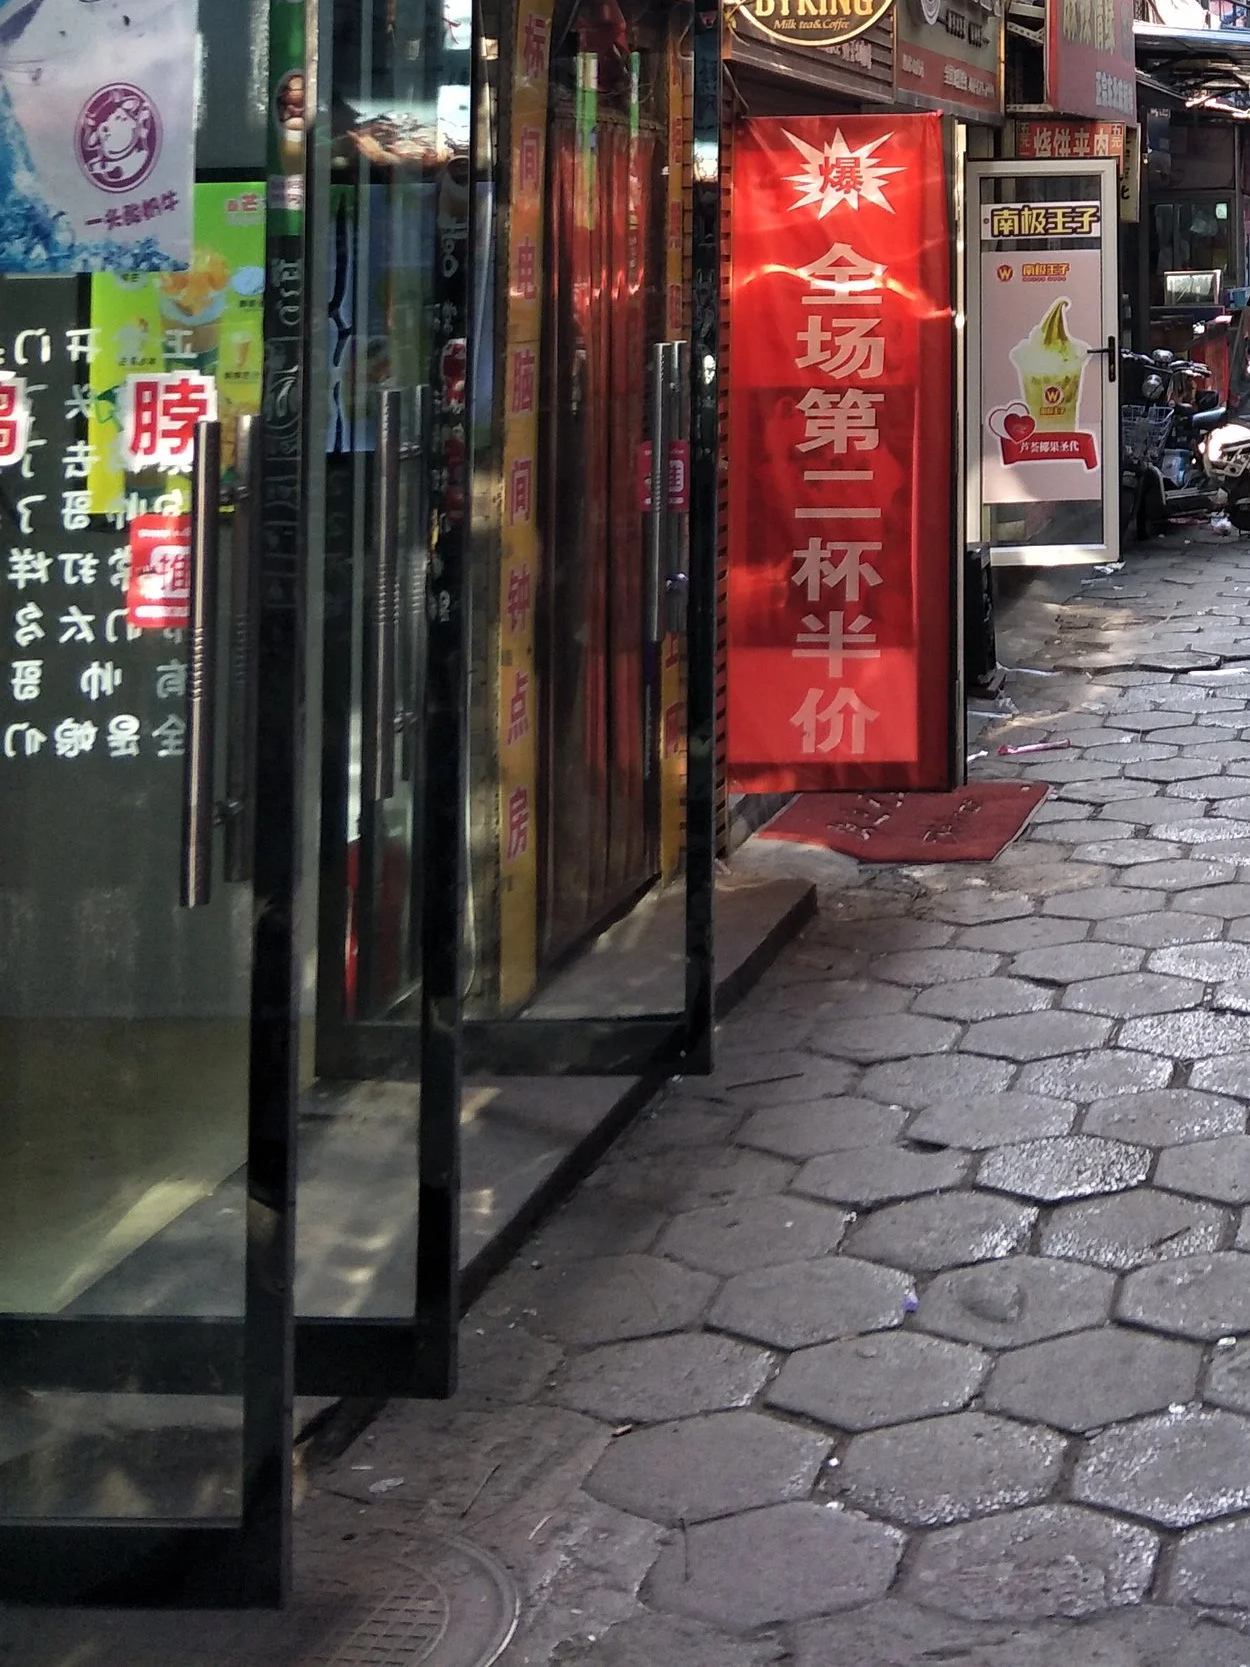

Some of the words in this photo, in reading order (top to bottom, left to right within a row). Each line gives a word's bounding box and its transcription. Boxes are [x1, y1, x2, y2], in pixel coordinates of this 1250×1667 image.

[818, 155, 865, 197] 爆
[990, 206, 1100, 237] 南极王子
[790, 241, 887, 756] 全场第二杯半价
